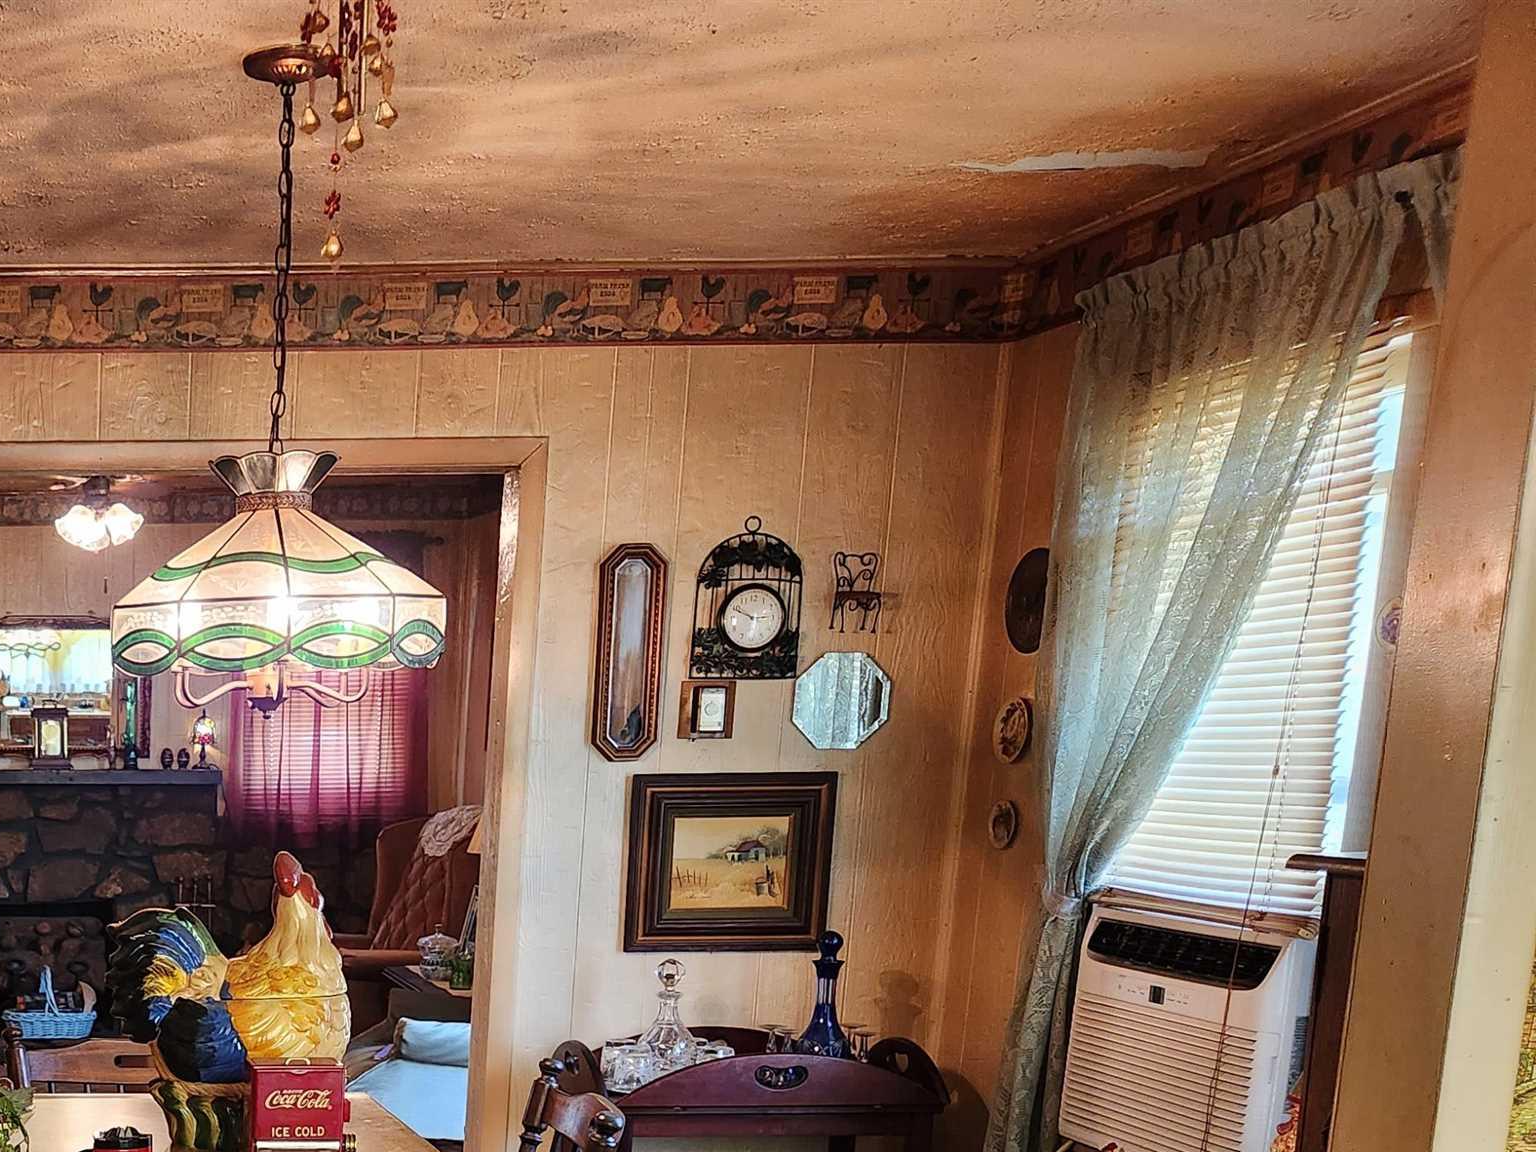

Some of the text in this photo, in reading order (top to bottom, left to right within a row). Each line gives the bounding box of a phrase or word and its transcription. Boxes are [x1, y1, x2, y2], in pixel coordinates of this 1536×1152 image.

[264, 1089, 333, 1110] Coca-Cola
[271, 1126, 325, 1138] ICE COLD
